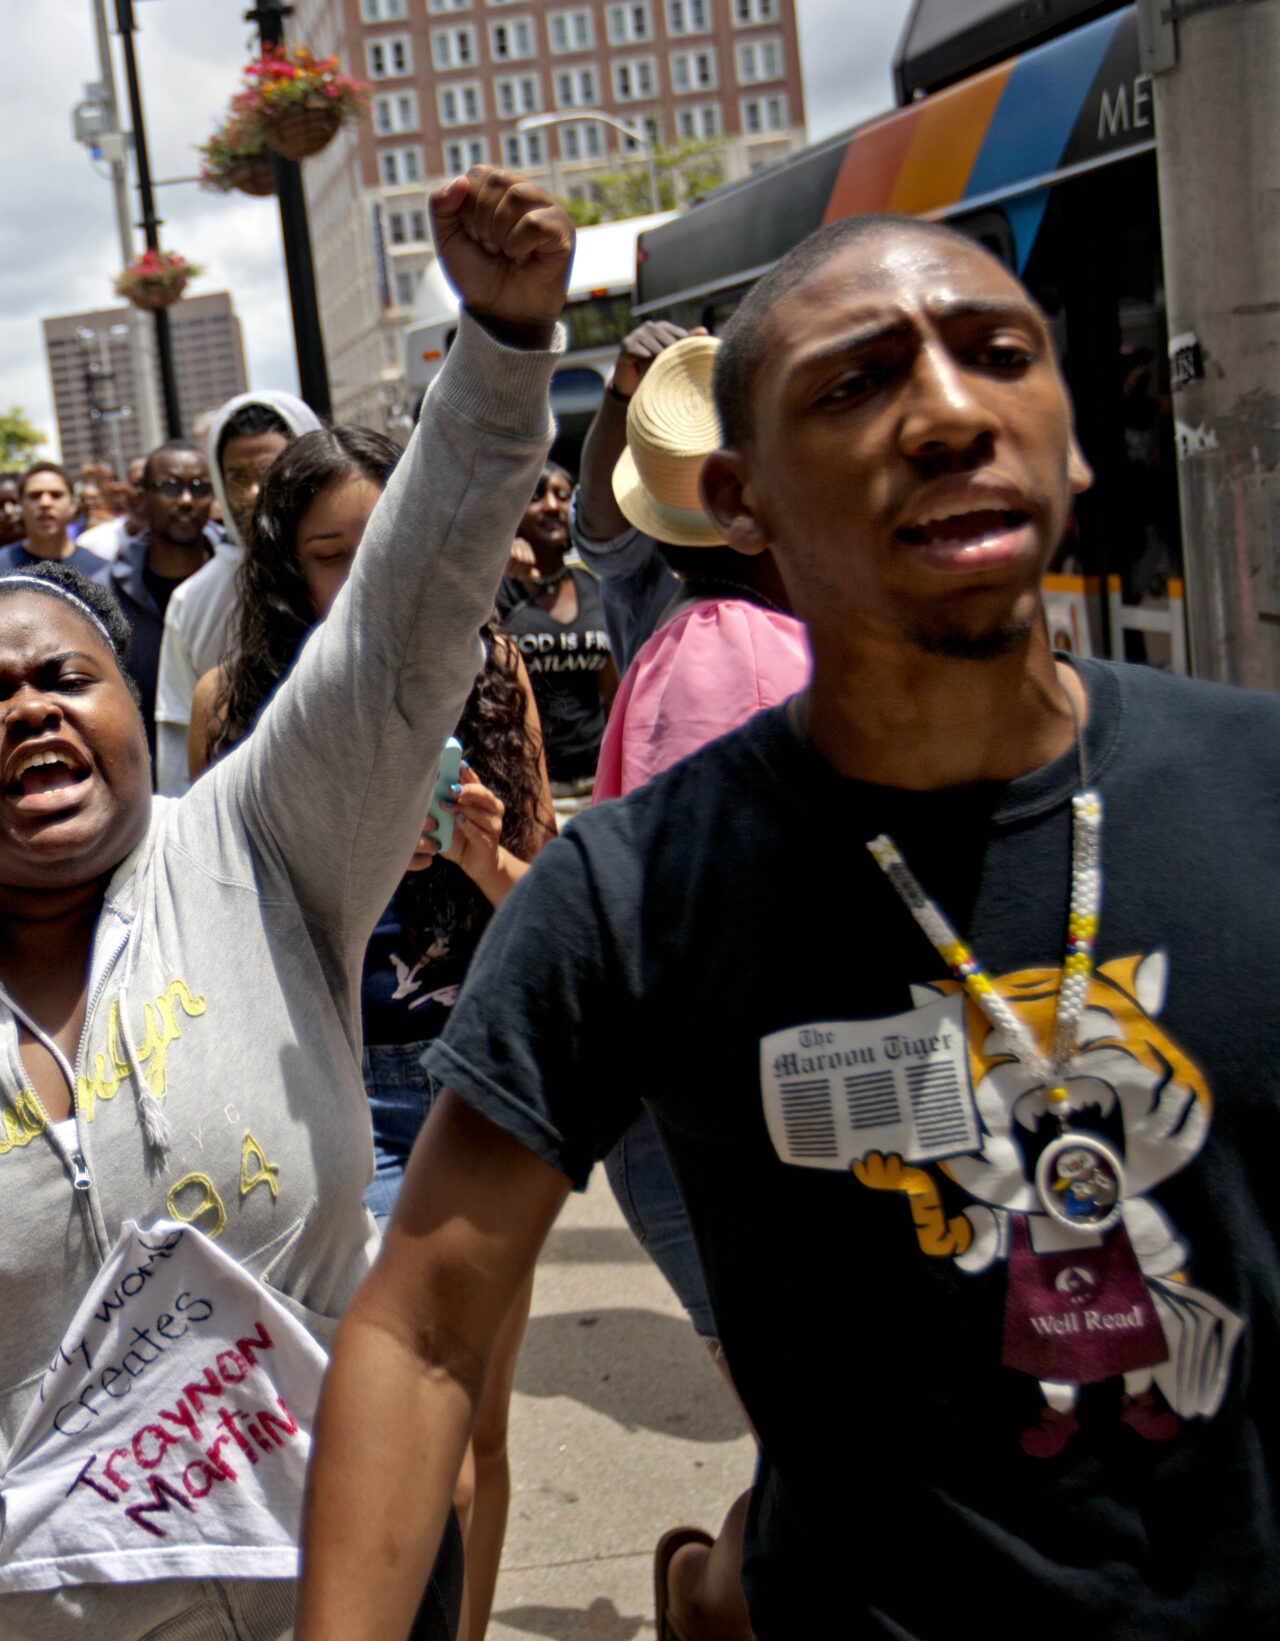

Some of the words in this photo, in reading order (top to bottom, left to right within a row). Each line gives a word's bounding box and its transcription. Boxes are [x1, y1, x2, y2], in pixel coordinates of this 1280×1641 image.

[511, 633, 555, 654] OD
[560, 632, 578, 651] IS
[798, 1028, 835, 1050] The
[773, 1047, 876, 1078] Maroon
[882, 1032, 953, 1061] Tiger
[1030, 1311, 1080, 1335] Well
[1083, 1304, 1145, 1331] Read
